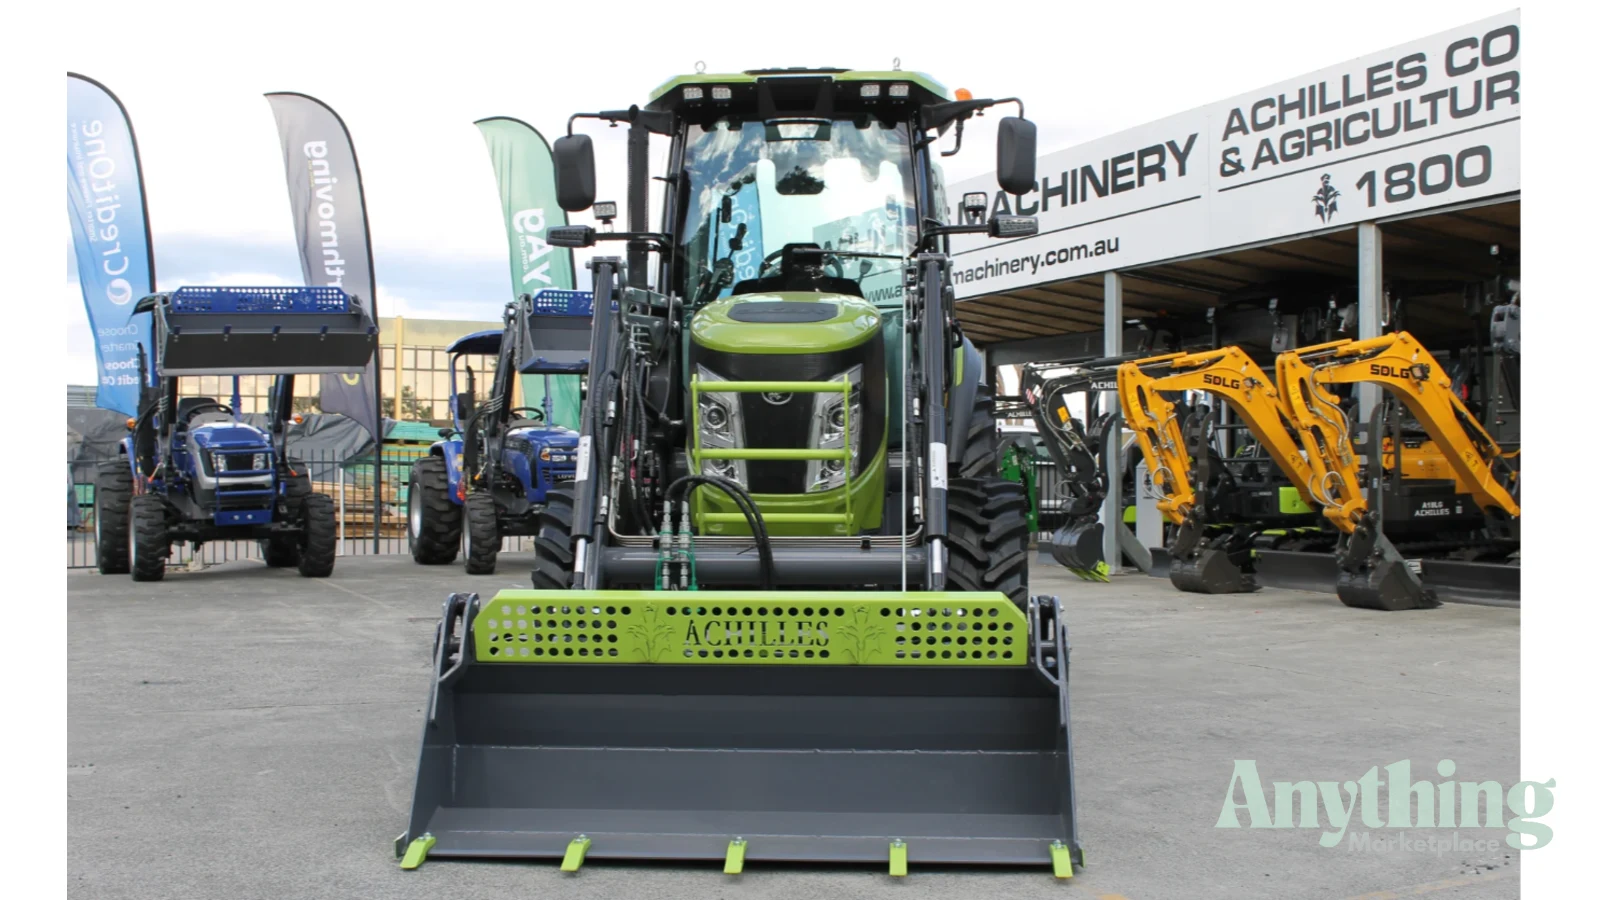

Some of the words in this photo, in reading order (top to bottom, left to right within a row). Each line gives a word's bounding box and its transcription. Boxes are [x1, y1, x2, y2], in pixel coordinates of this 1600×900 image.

[1221, 52, 1427, 141] ACHILLES
[1445, 25, 1519, 77] CO
[1219, 147, 1244, 178] &
[1251, 70, 1519, 171] AGRICULTUR
[958, 133, 1199, 225] MACHINERY
[1356, 145, 1492, 207] 1800
[1203, 374, 1240, 389] SDLG
[1370, 364, 1410, 379] SDLG
[1414, 508, 1450, 516] ACHILLES
[682, 619, 829, 647] ACHILLES
